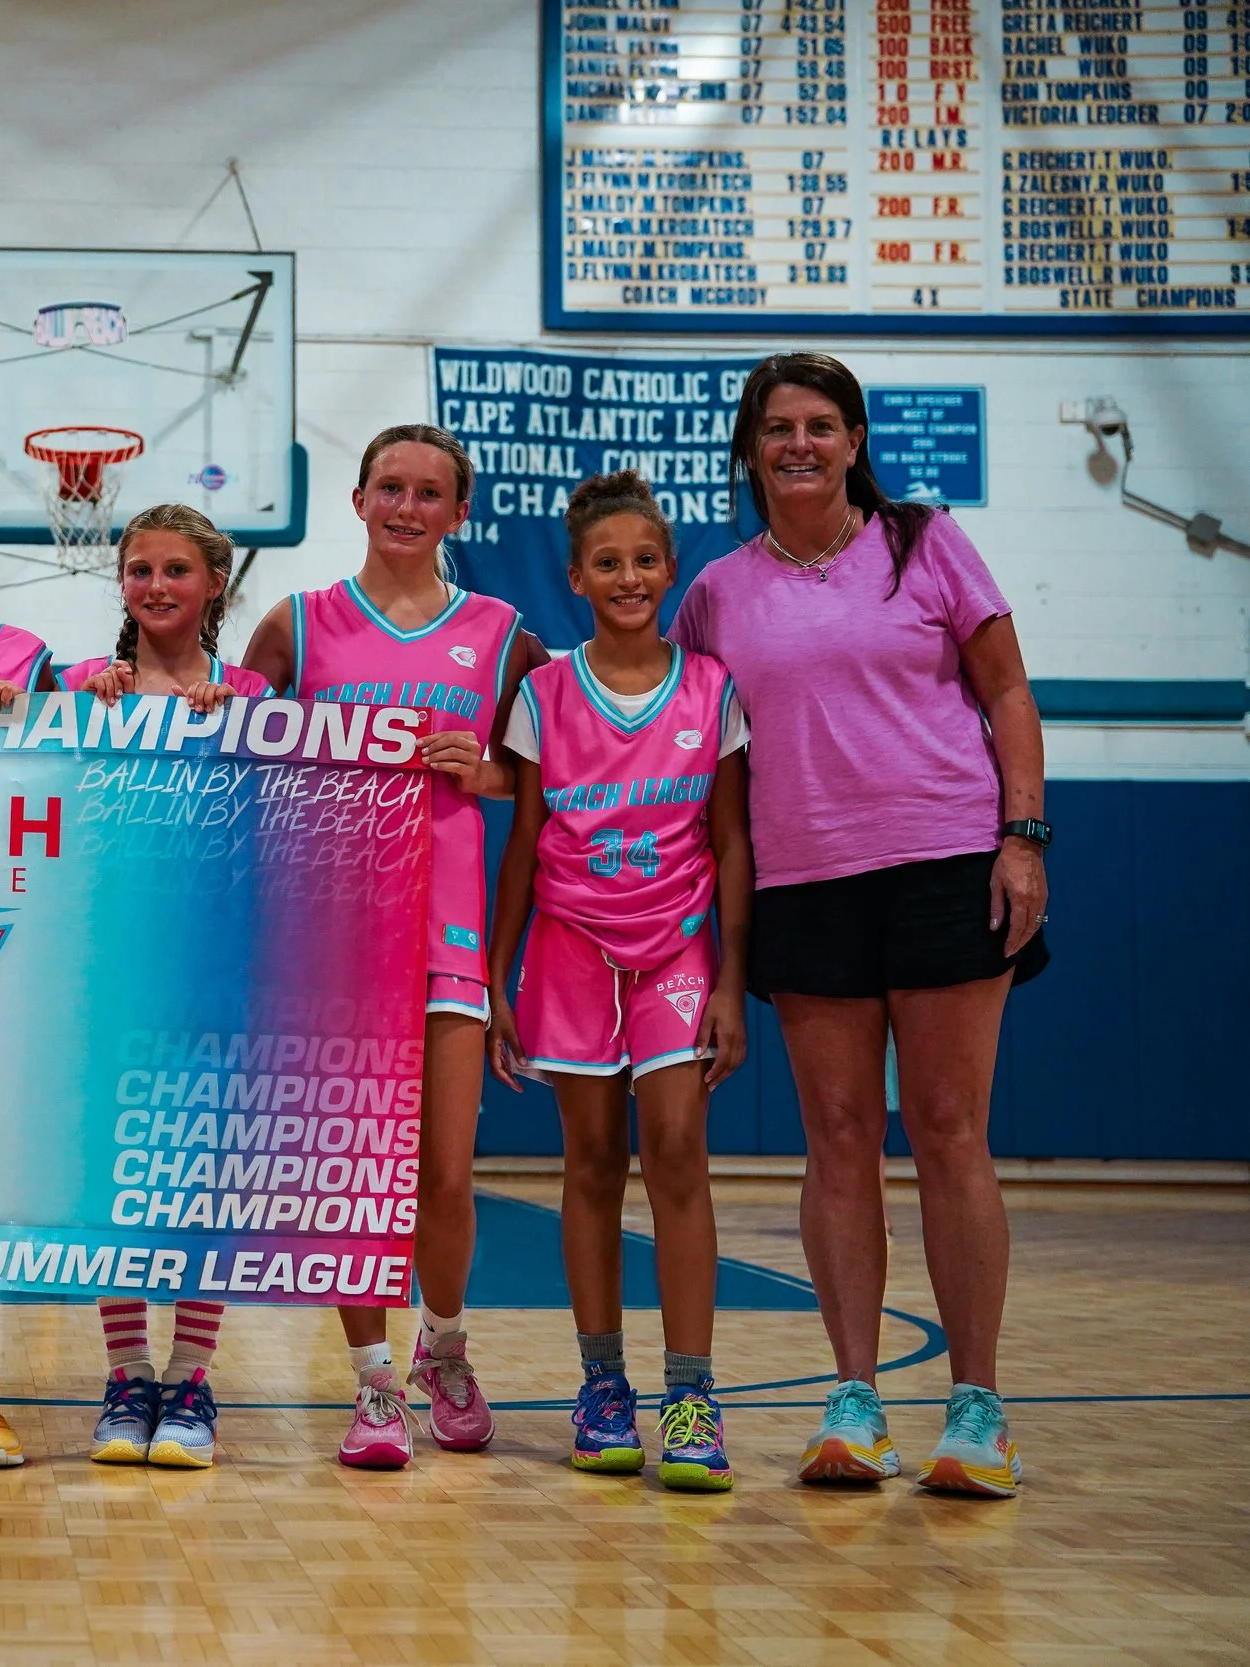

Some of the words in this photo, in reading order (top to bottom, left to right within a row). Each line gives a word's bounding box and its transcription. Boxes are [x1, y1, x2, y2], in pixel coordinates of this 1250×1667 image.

[930, 13, 971, 33] FREE
[878, 37, 909, 57] 100
[930, 37, 973, 56] BACK
[1002, 35, 1067, 56] RACHEL
[1004, 58, 1048, 78] TARA
[877, 106, 910, 126] 200
[1002, 104, 1079, 125] VICTORIA
[881, 128, 967, 149] RELAYS
[879, 152, 915, 172] 200
[622, 286, 678, 304] COACH
[1060, 289, 1113, 309] STATE
[1136, 288, 1236, 309] CHAMPIONS
[439, 359, 572, 398] WILDWOOD
[583, 369, 709, 403] CATHOLIC
[442, 400, 515, 434] CAPE
[527, 405, 664, 443] ATLANTIC
[463, 440, 582, 479] ATIONAL
[492, 482, 731, 524] CHAONS
[452, 521, 499, 544] 014
[398, 682, 484, 722] LEAGUE
[74, 758, 204, 794] BALLIN
[198, 762, 252, 798] BY
[255, 764, 318, 800] THE
[309, 768, 425, 808] BEACH
[543, 783, 624, 813] BEACH
[74, 791, 202, 827] BALLIN
[197, 795, 252, 830] BY
[255, 797, 317, 833] THE
[308, 802, 425, 840] BEACH
[588, 828, 661, 878] 34
[656, 976, 705, 992] BEACH
[118, 1031, 426, 1075] CHAMPIONS
[115, 1070, 423, 1115] CHAMPIONS
[113, 1109, 421, 1156] CHAMPIONS
[112, 1149, 420, 1194] CHAMPIONS
[111, 1189, 418, 1234] CHAMPIONS
[197, 1249, 408, 1297] LEAGUE
